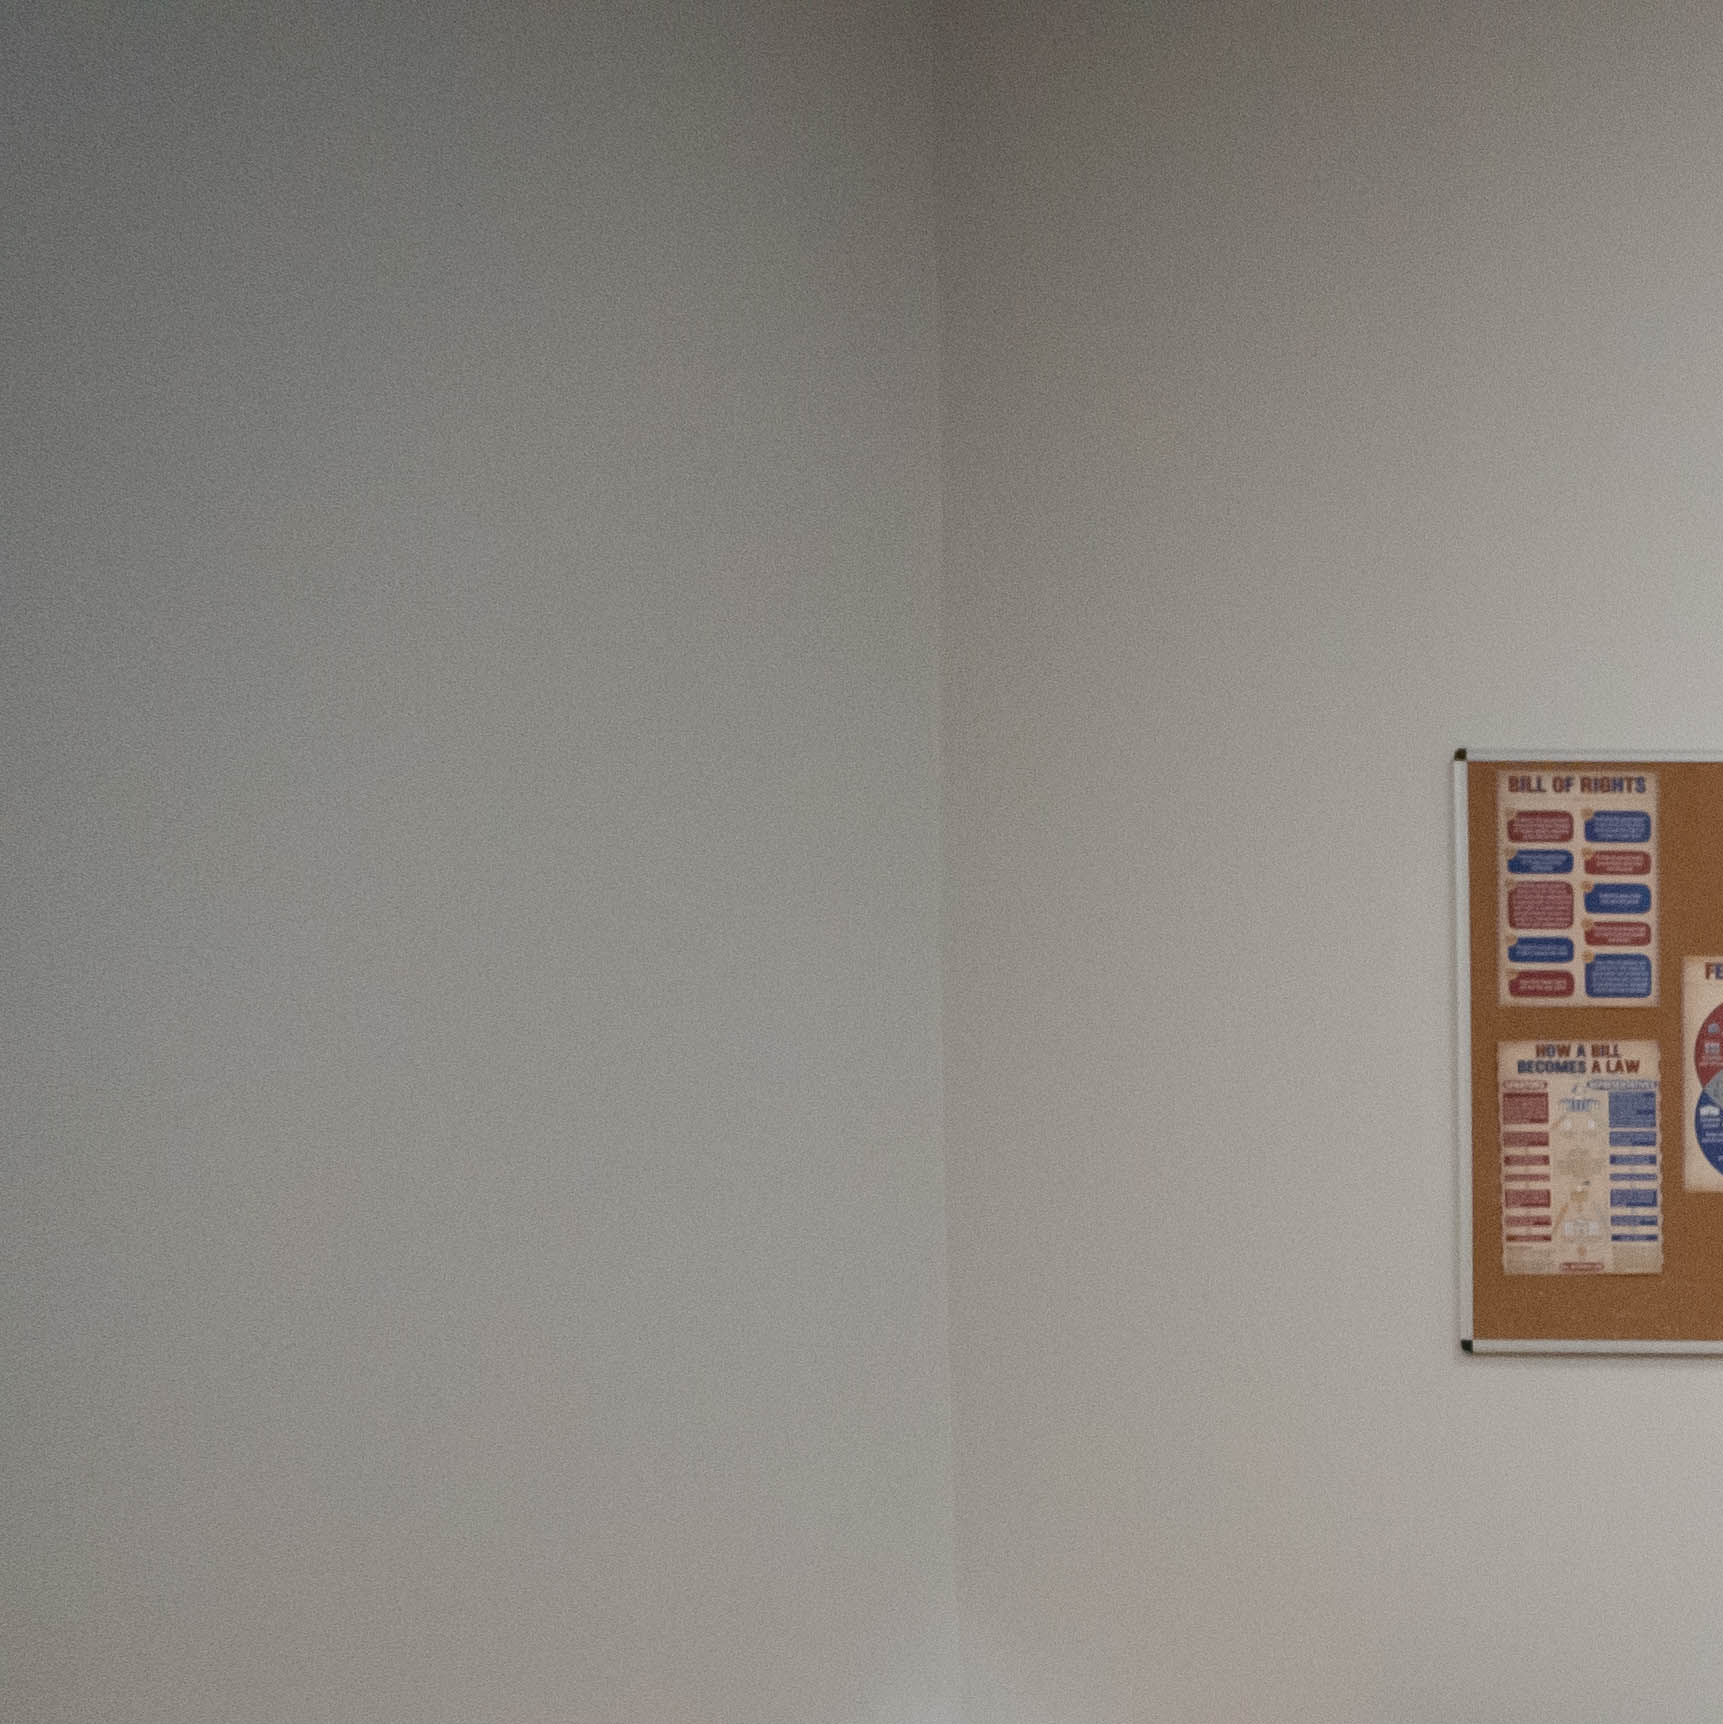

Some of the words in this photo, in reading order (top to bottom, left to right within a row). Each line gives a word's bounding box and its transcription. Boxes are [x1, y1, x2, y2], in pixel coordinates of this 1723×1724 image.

[1508, 776, 1546, 793] BILL
[1552, 776, 1575, 793] OF
[1580, 776, 1647, 793] RIGHTS
[1535, 1044, 1572, 1058] HOW
[1576, 1044, 1586, 1058] A
[1591, 1044, 1621, 1058] BILL
[1517, 1059, 1587, 1074] BECOMES
[1591, 1060, 1602, 1073] A
[1606, 1060, 1641, 1074] LAW
